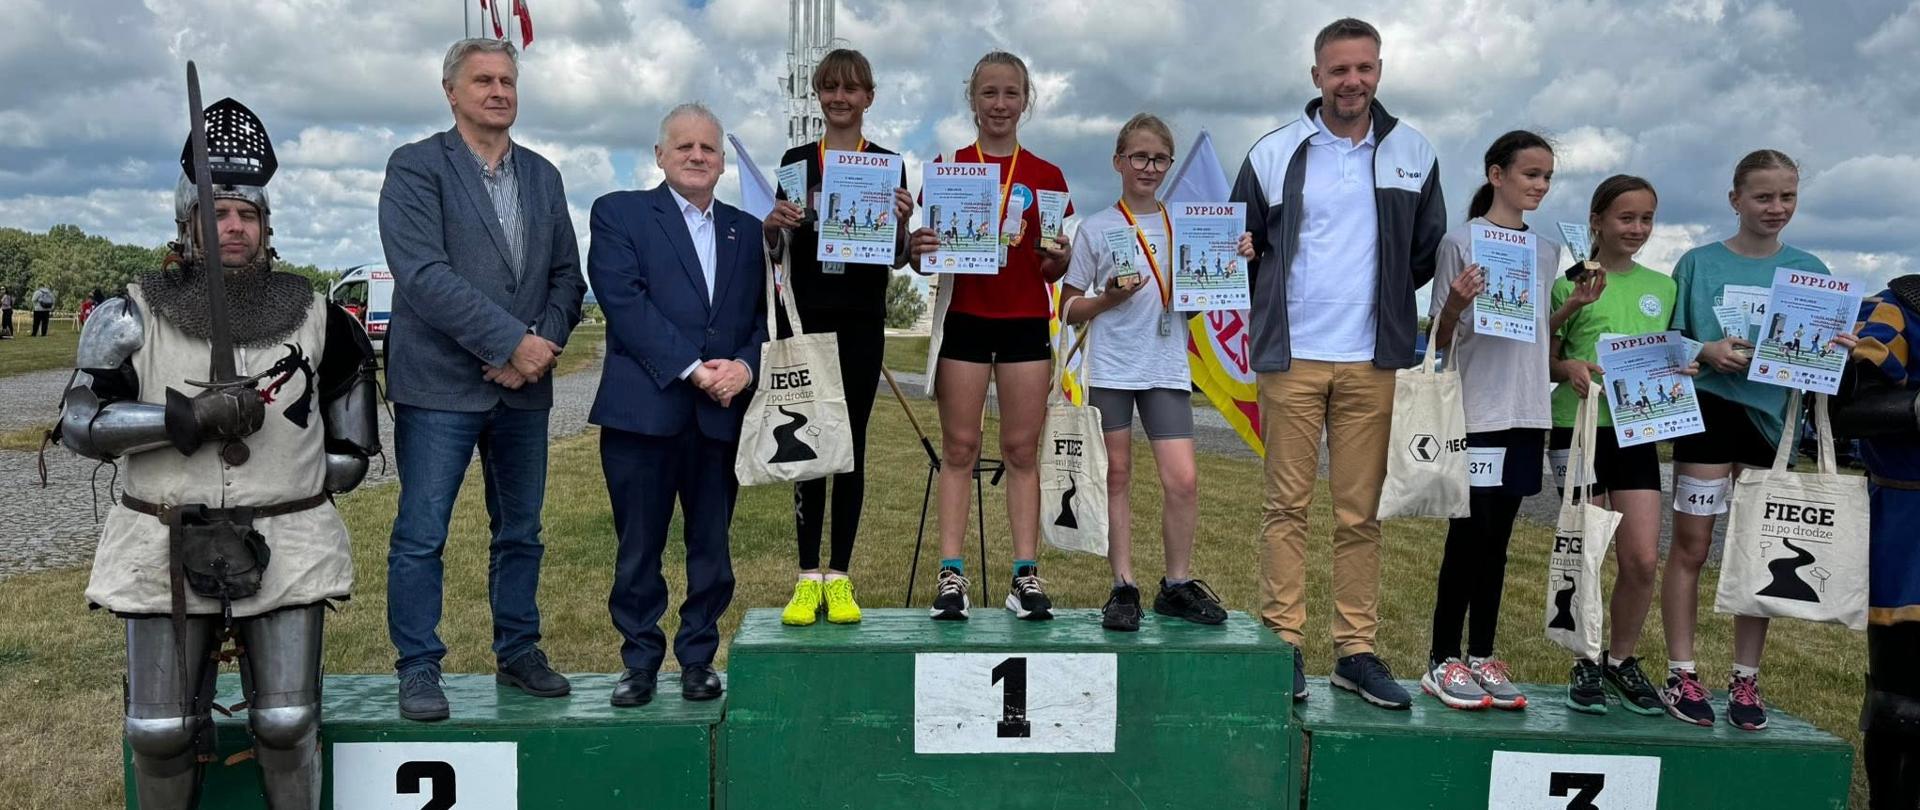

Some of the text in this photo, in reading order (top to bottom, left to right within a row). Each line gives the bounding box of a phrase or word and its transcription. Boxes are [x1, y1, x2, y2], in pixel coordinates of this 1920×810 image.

[839, 155, 889, 167] DYPLOM
[937, 167, 987, 176] DYPLOM
[1185, 206, 1234, 216] DYPLOM
[1484, 230, 1526, 245] DYPLOM
[1135, 243, 1157, 255] 13
[1790, 274, 1849, 292] DYPLOM
[1611, 335, 1667, 351] DYPLOM
[770, 369, 811, 390] IEGE
[1469, 461, 1492, 474] 371
[1688, 493, 1714, 505] 414
[1764, 502, 1835, 526] FIEGE
[1761, 523, 1833, 539] mi po drodze
[991, 657, 1031, 738] 1
[396, 760, 457, 810] 2
